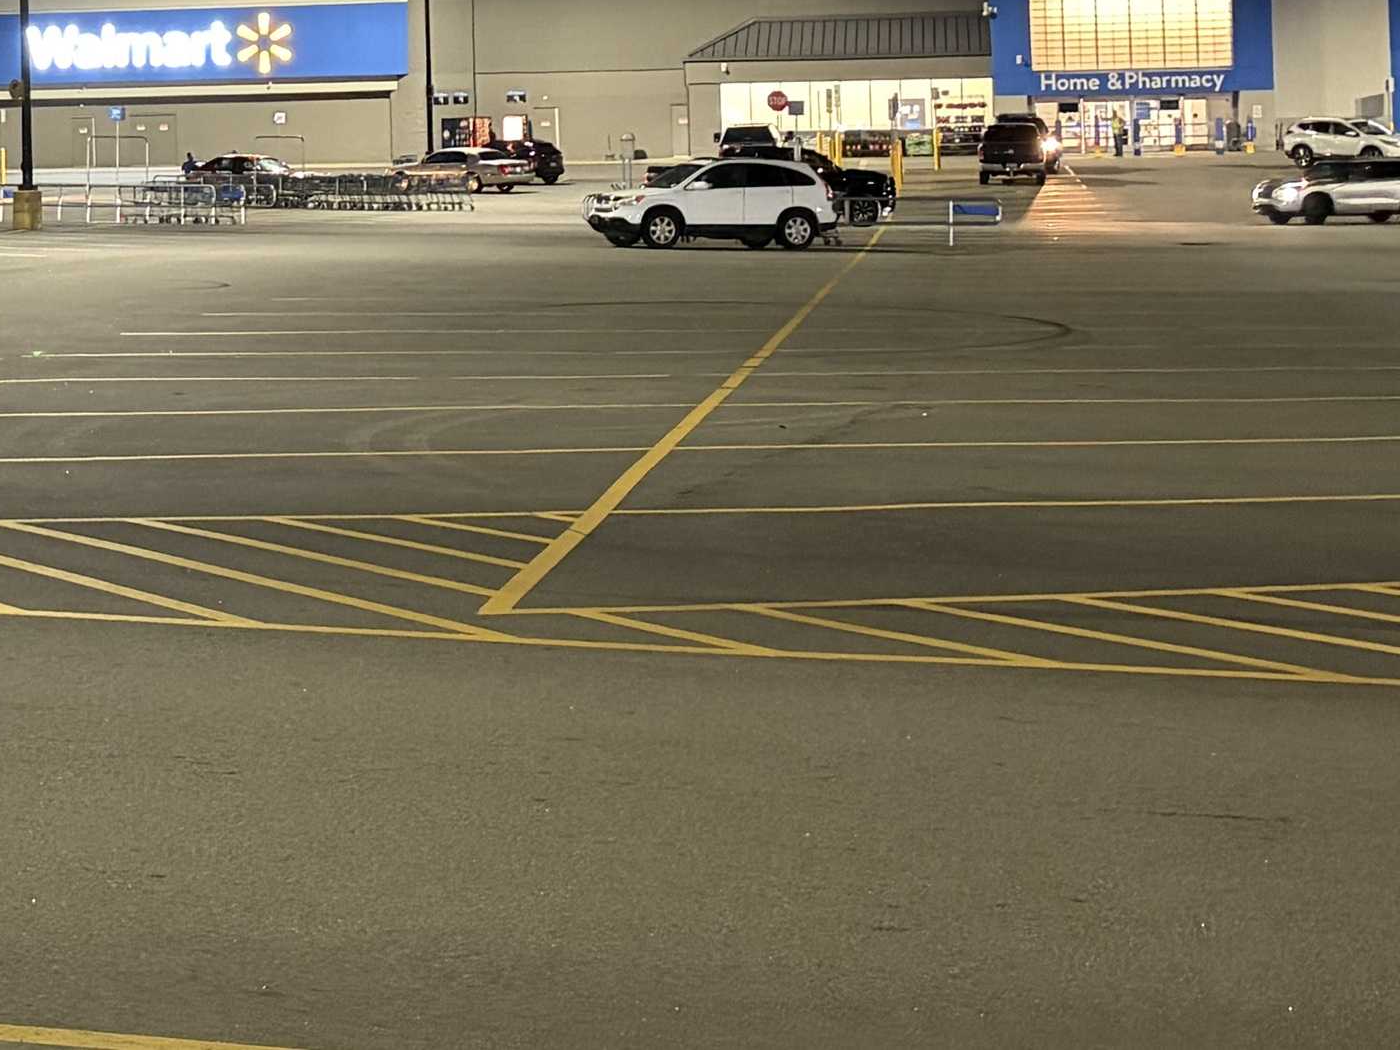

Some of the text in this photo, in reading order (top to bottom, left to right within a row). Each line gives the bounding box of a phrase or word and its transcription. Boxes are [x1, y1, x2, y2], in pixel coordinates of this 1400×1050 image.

[25, 19, 233, 71] Walmart
[1040, 72, 1225, 92] Home & Pharmacy
